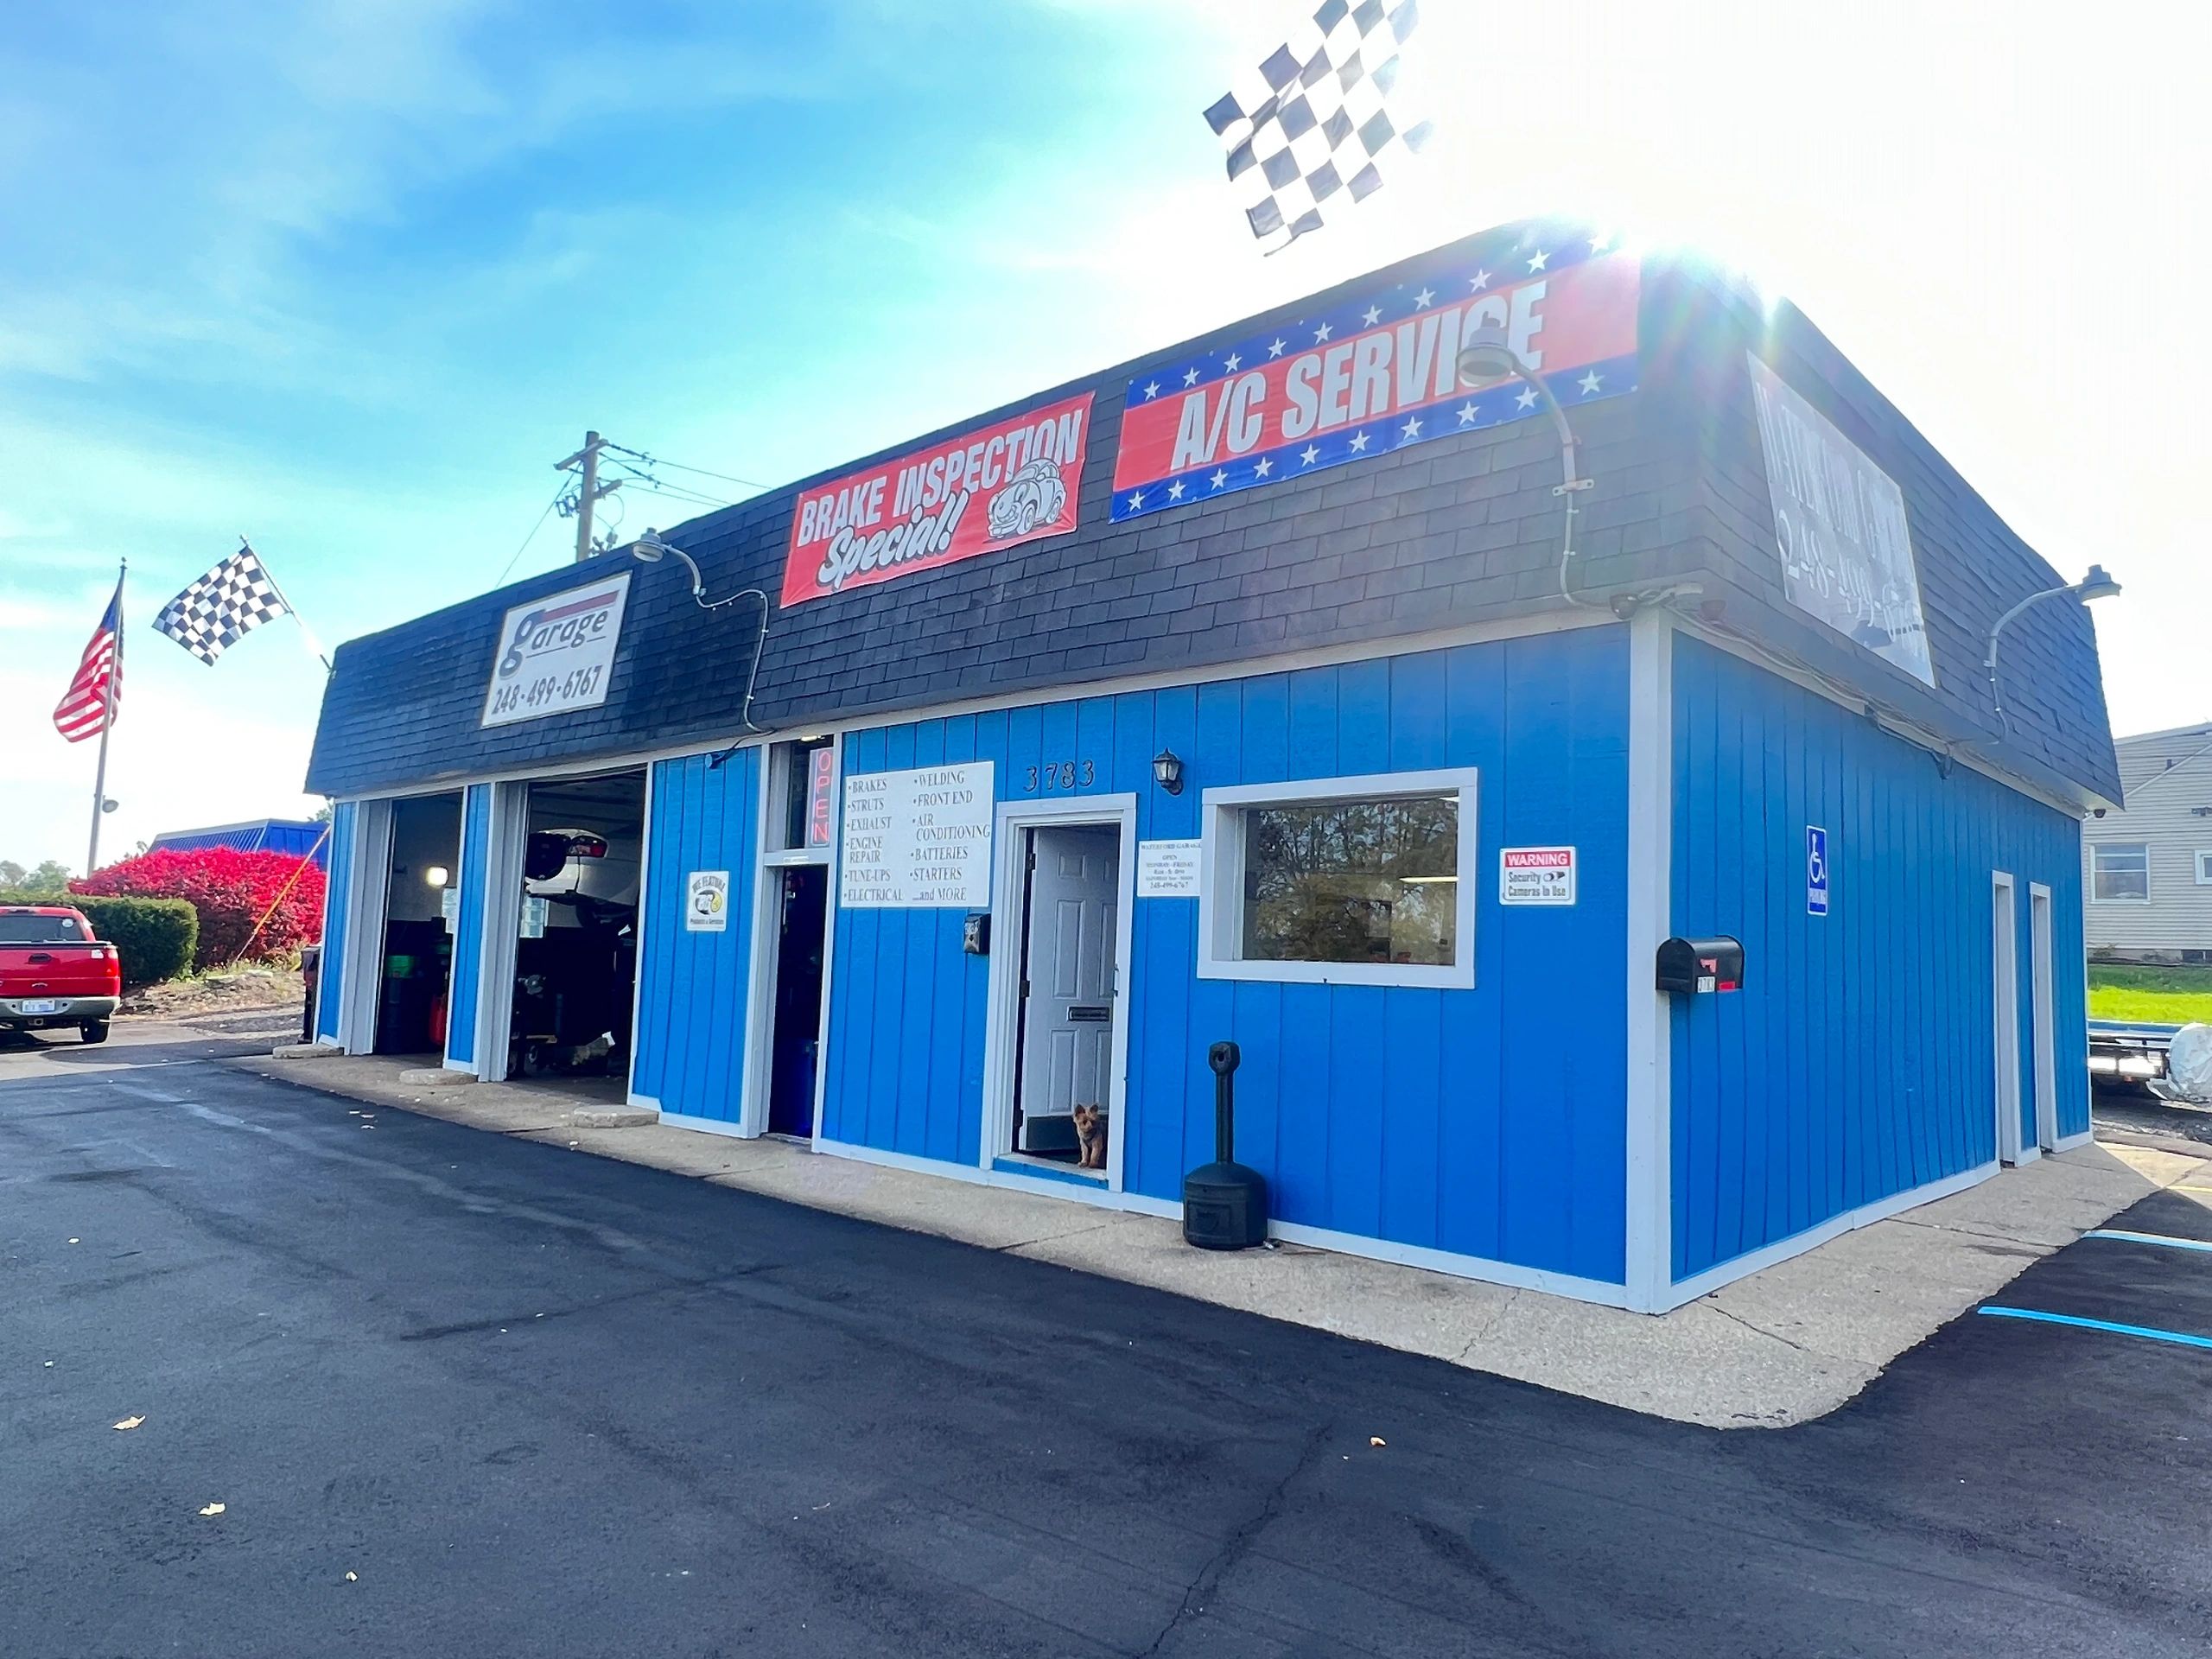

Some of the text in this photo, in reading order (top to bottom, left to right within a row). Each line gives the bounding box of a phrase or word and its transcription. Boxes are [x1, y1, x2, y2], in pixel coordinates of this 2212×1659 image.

[1169, 372, 1267, 471] A/C
[797, 409, 1084, 548] BRAKE INSPECTION
[817, 487, 969, 589] Special!
[498, 608, 608, 679] garage
[918, 771, 965, 787] WELDING
[1023, 759, 1095, 792] 3783
[852, 779, 887, 794] BRAKES
[814, 751, 831, 842] OPEN
[918, 790, 973, 807] FRONT END
[850, 798, 885, 812] STRUTS
[850, 817, 892, 831] EXHAUST
[917, 813, 934, 827] AIR
[916, 824, 991, 842] CONDITIONING
[849, 836, 883, 849] ENGINE
[849, 850, 881, 864] REPAIR
[915, 846, 969, 861] BATTERIES
[1507, 853, 1568, 866] WARNING
[849, 868, 892, 882] TUNE-UPS
[912, 867, 963, 881] STARTERS
[1509, 871, 1541, 884] Security
[848, 887, 904, 902] ELECTRICAL
[938, 887, 967, 901] MORE
[1509, 886, 1540, 896] Cameras
[1552, 885, 1566, 896] Use
